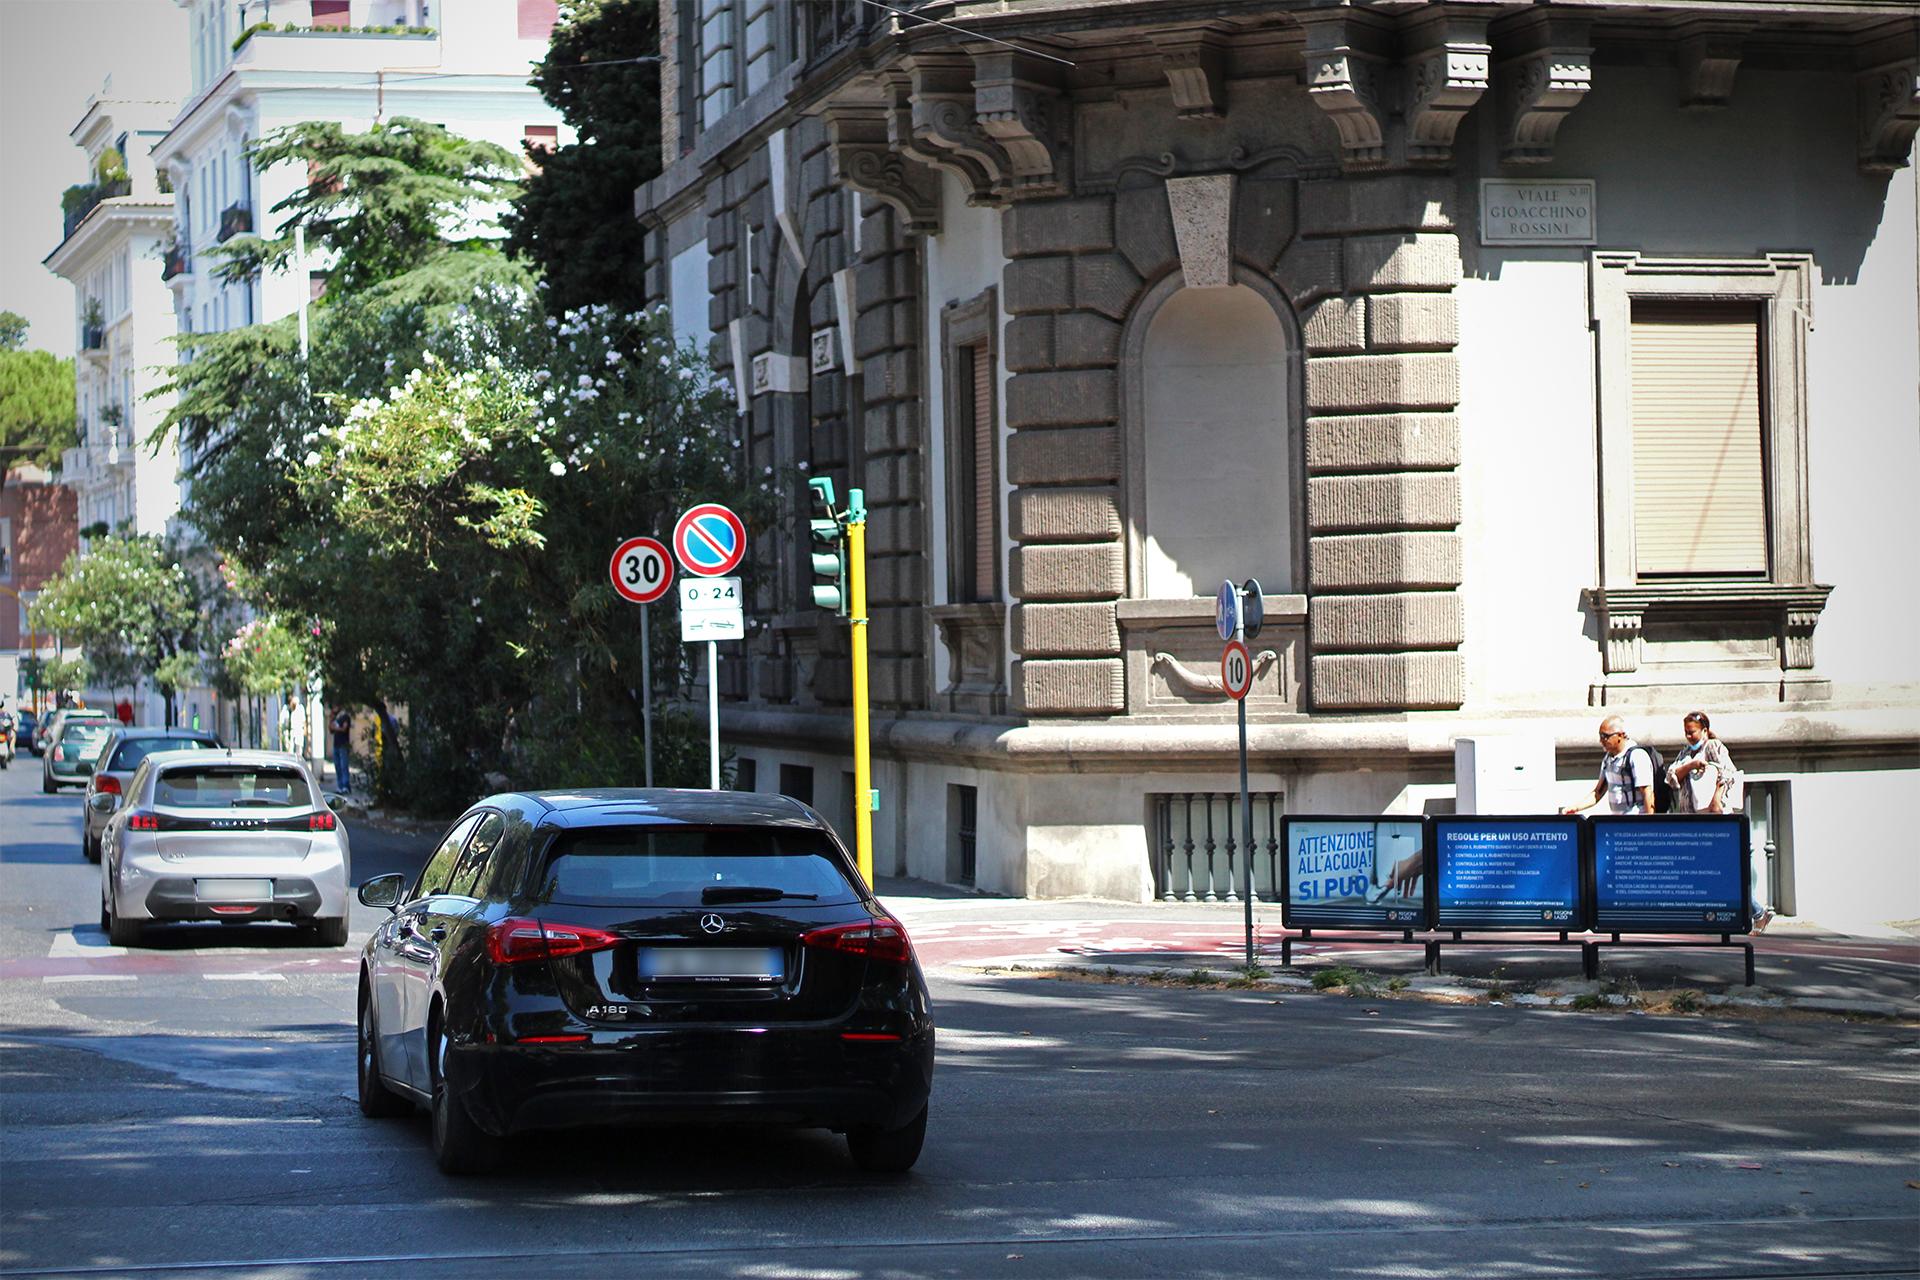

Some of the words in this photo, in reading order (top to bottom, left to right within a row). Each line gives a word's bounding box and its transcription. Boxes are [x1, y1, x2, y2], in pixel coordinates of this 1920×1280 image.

[1518, 189, 1560, 202] VIALE
[1490, 206, 1587, 218] GIOACCHINO
[1510, 222, 1569, 235] ROSSINI
[625, 554, 660, 585] 30
[712, 586, 735, 599] 24
[1228, 656, 1244, 685] 10
[1298, 830, 1375, 856] ATTENZIONE
[1446, 832, 1479, 841] REGOLE
[1480, 832, 1498, 841] PER
[1498, 832, 1511, 841] UN
[1511, 832, 1529, 841] USO
[1530, 832, 1568, 841] ATTENTO
[1298, 850, 1373, 875] ALL'ACQUA!
[1298, 879, 1318, 901] SI
[589, 1005, 600, 1014] A
